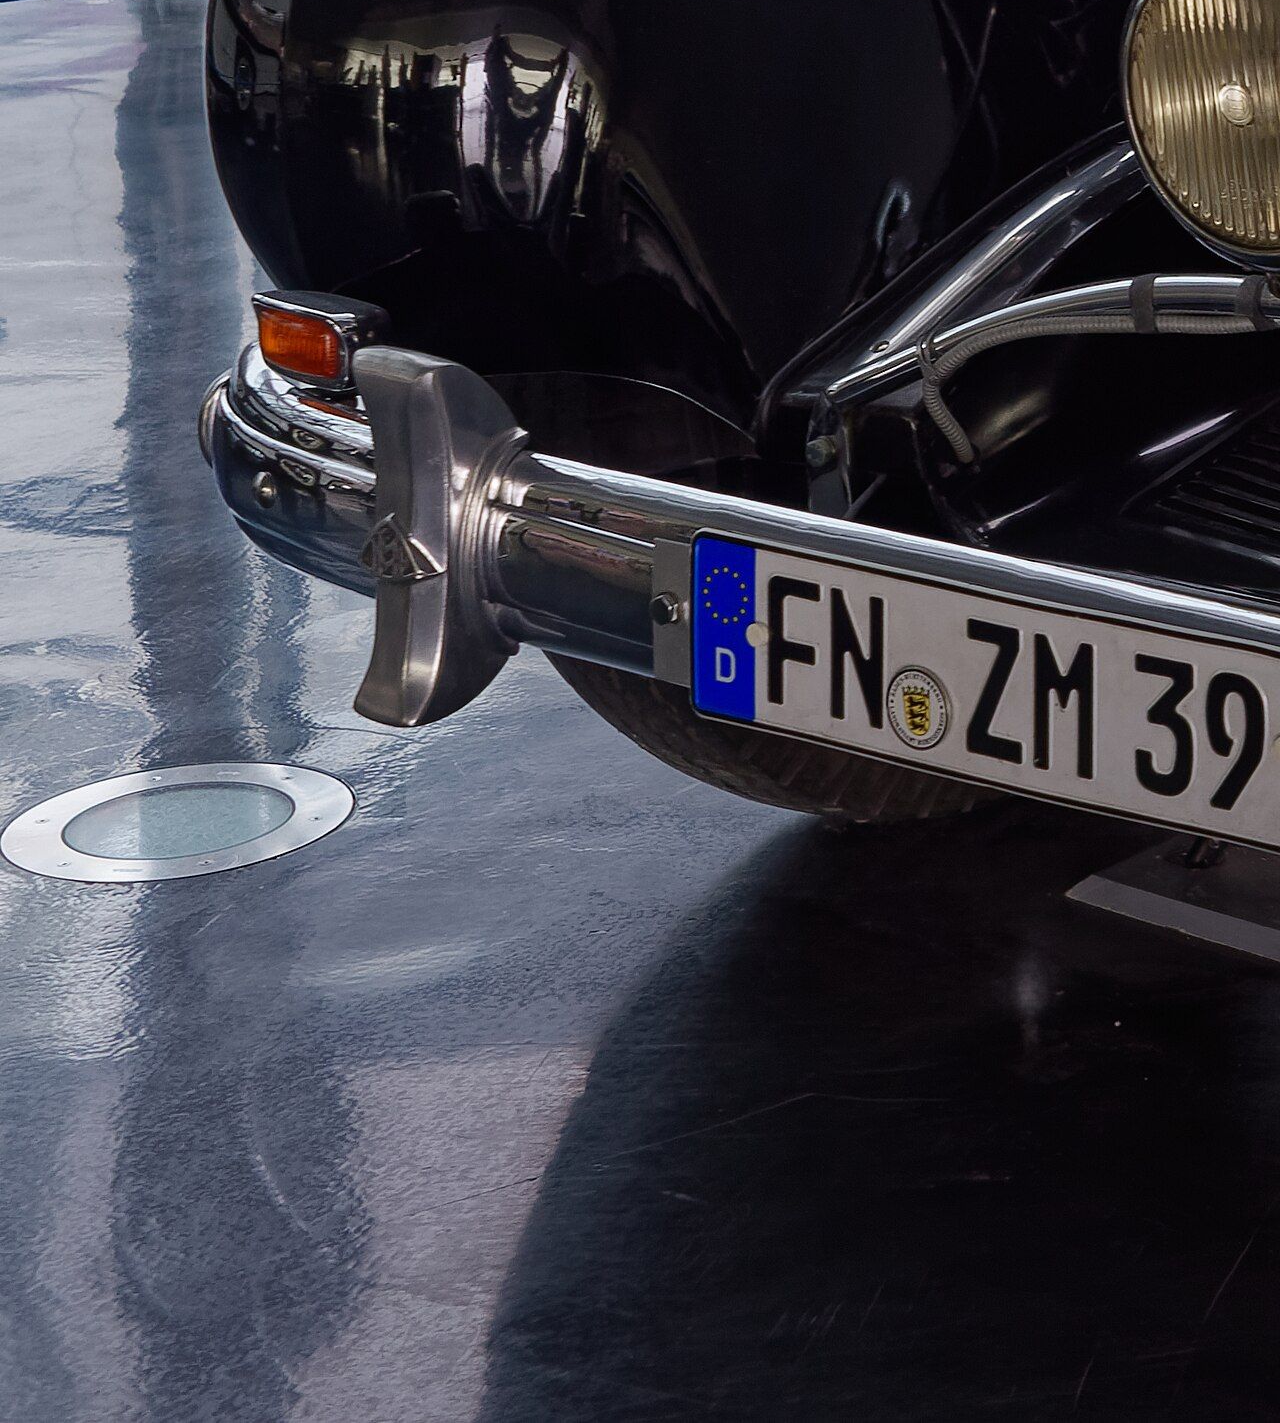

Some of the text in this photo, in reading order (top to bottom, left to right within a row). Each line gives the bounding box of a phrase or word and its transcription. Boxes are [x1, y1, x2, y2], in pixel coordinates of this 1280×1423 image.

[715, 645, 737, 684] D
[766, 574, 886, 731] FN
[966, 617, 1095, 781] ZM
[1134, 653, 1266, 811] 39
